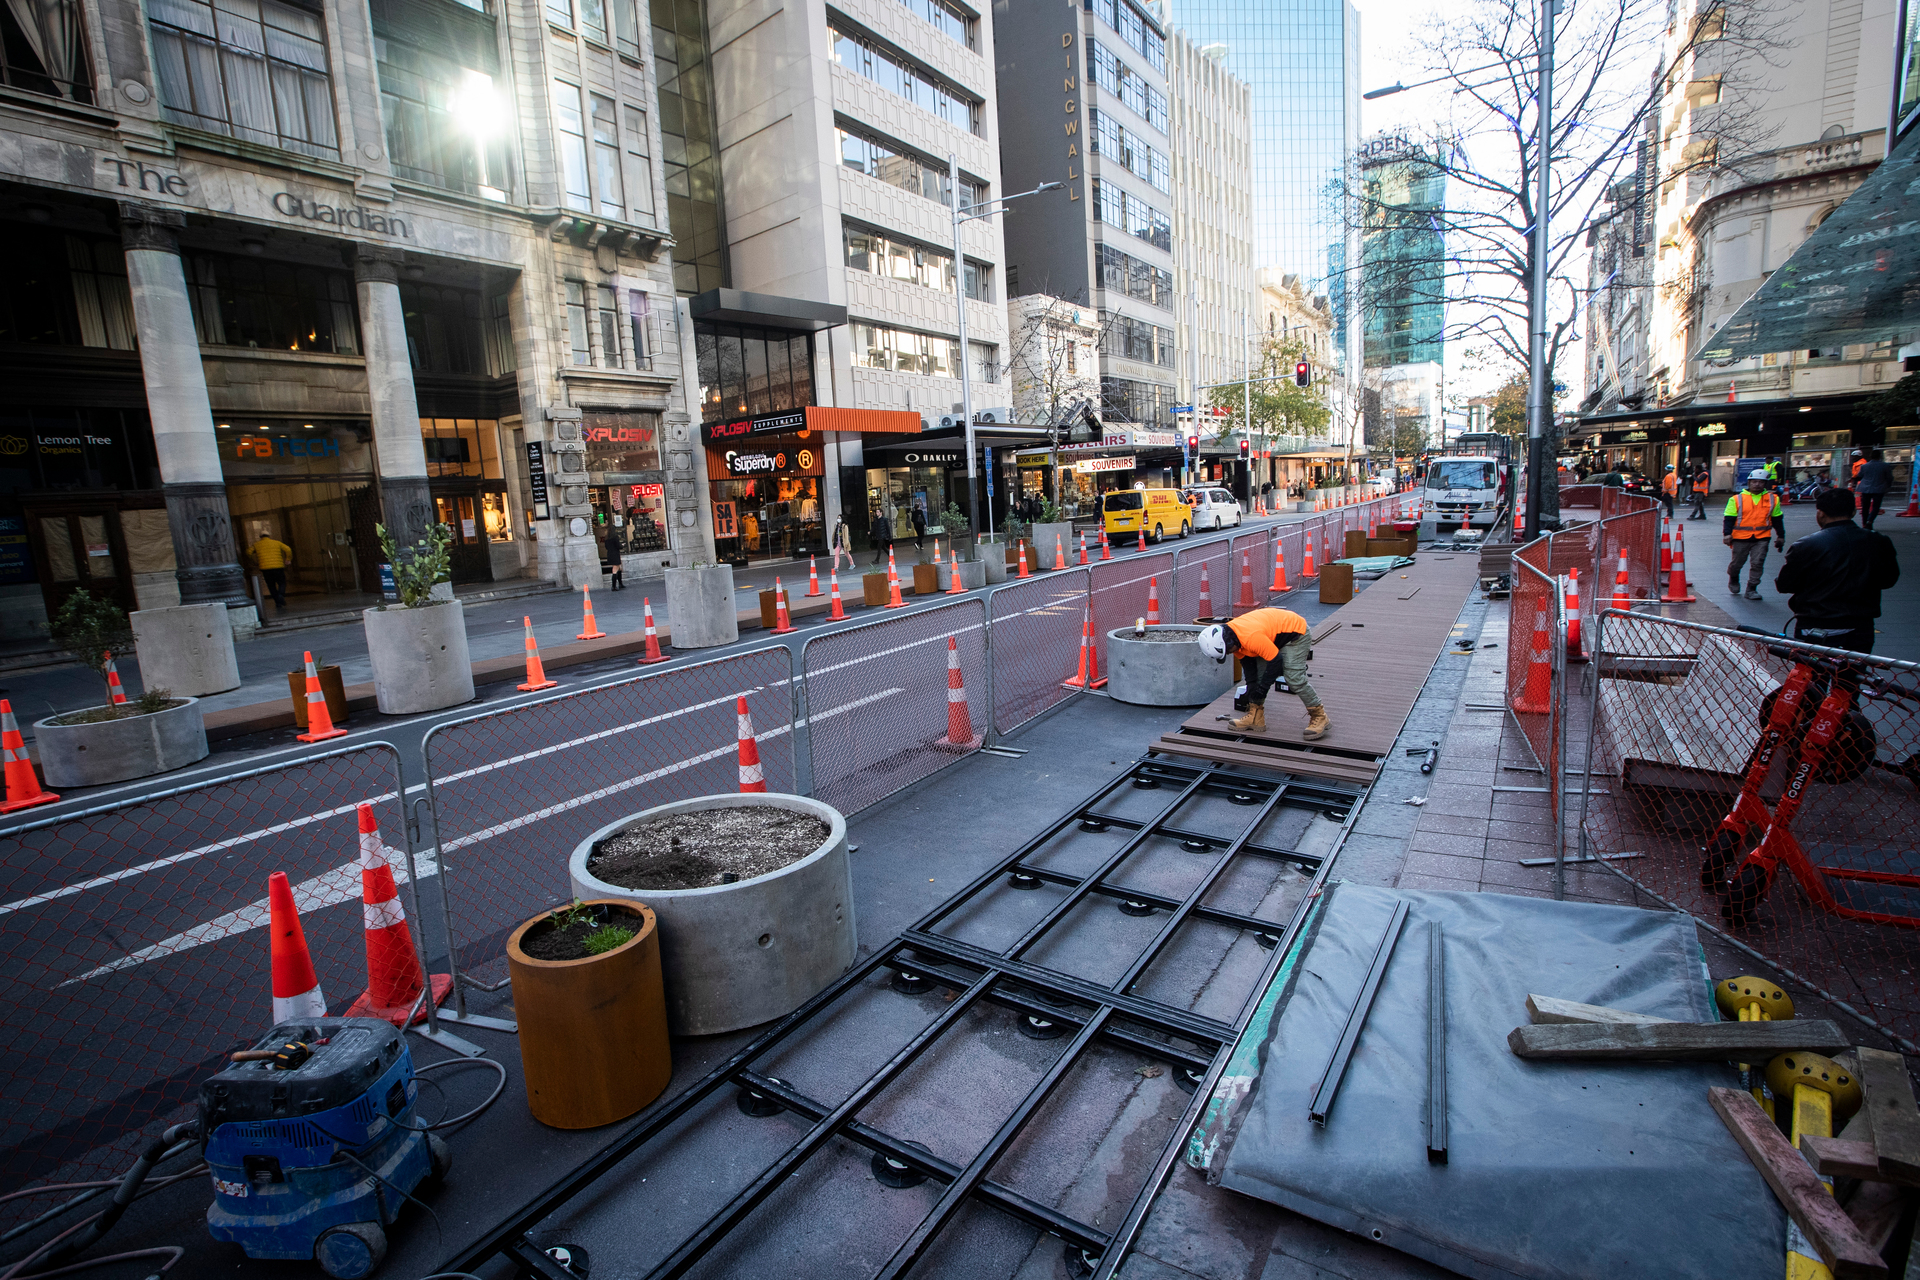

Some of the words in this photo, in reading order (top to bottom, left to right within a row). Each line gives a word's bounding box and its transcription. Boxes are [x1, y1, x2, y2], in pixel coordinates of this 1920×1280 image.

[1062, 32, 1079, 202] DINGWALL
[103, 158, 189, 197] The
[272, 192, 409, 238] Guardian
[710, 420, 752, 438] XPLOSIV
[753, 417, 803, 429] SUPPLEMENTS
[37, 435, 81, 445] Lemon
[84, 435, 112, 445] Tree
[586, 428, 653, 442] XPLOSIV
[1148, 435, 1174, 445] SOUVENIRS
[39, 446, 82, 455] Organics
[923, 454, 957, 462] OAKLEY
[1092, 458, 1133, 470] SOUVENIRS
[1152, 495, 1170, 504] DHL
